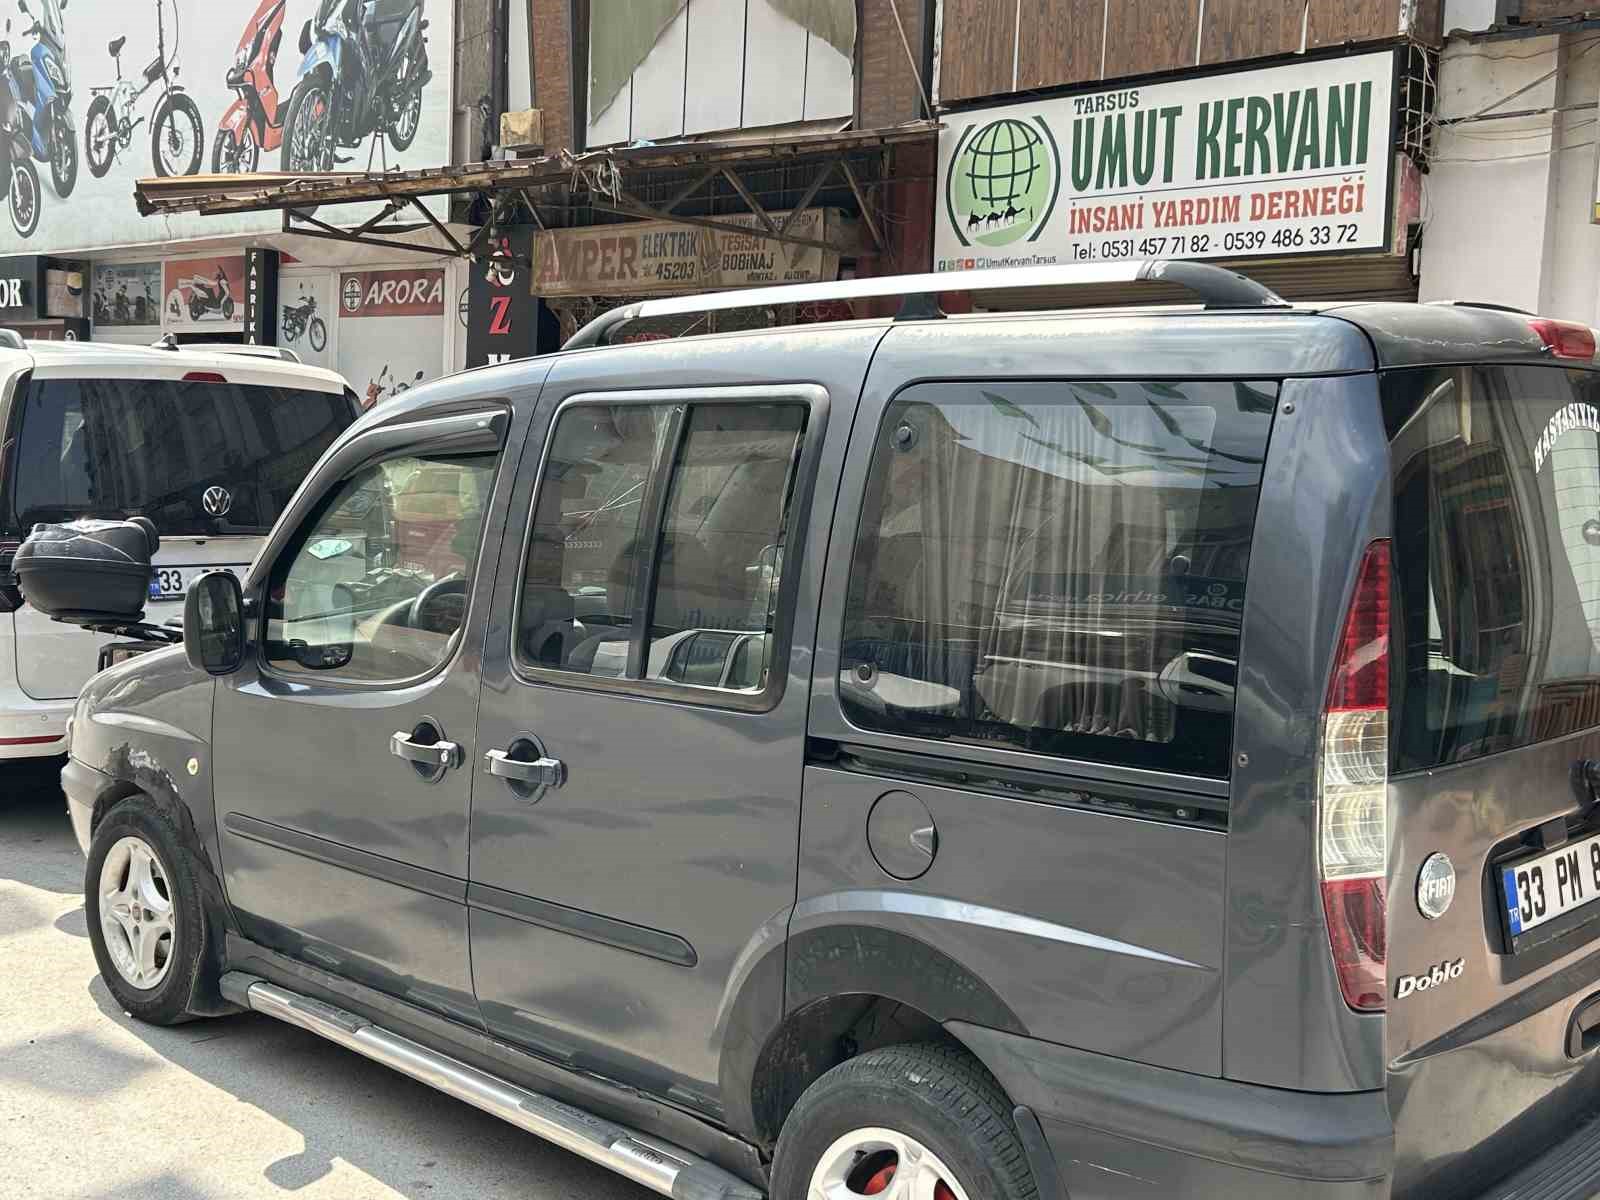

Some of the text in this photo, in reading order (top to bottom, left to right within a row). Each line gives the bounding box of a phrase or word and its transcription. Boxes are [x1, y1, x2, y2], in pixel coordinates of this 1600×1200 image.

[1073, 90, 1140, 115] TARSUS
[1071, 80, 1373, 192] UMUT KERVANI
[1069, 175, 1366, 235] İNSANİ YARDIM DERNEĞİ
[1072, 242, 1097, 260] Tel:
[1101, 239, 1134, 258] 0531
[1138, 237, 1167, 255] 457
[1171, 236, 1186, 254] 71
[1190, 234, 1210, 253] 82
[1224, 231, 1266, 251] 0539
[1271, 228, 1304, 248] 486
[1309, 226, 1331, 246] 33
[1336, 223, 1358, 244] 72
[538, 236, 638, 282] AMPER
[655, 261, 696, 281] 45203
[364, 278, 442, 305] ARORA
[159, 570, 182, 592] 33
[1428, 875, 1453, 899] FIAT
[1509, 907, 1520, 923] TR
[1517, 865, 1547, 923] 33
[1555, 850, 1583, 907] PM
